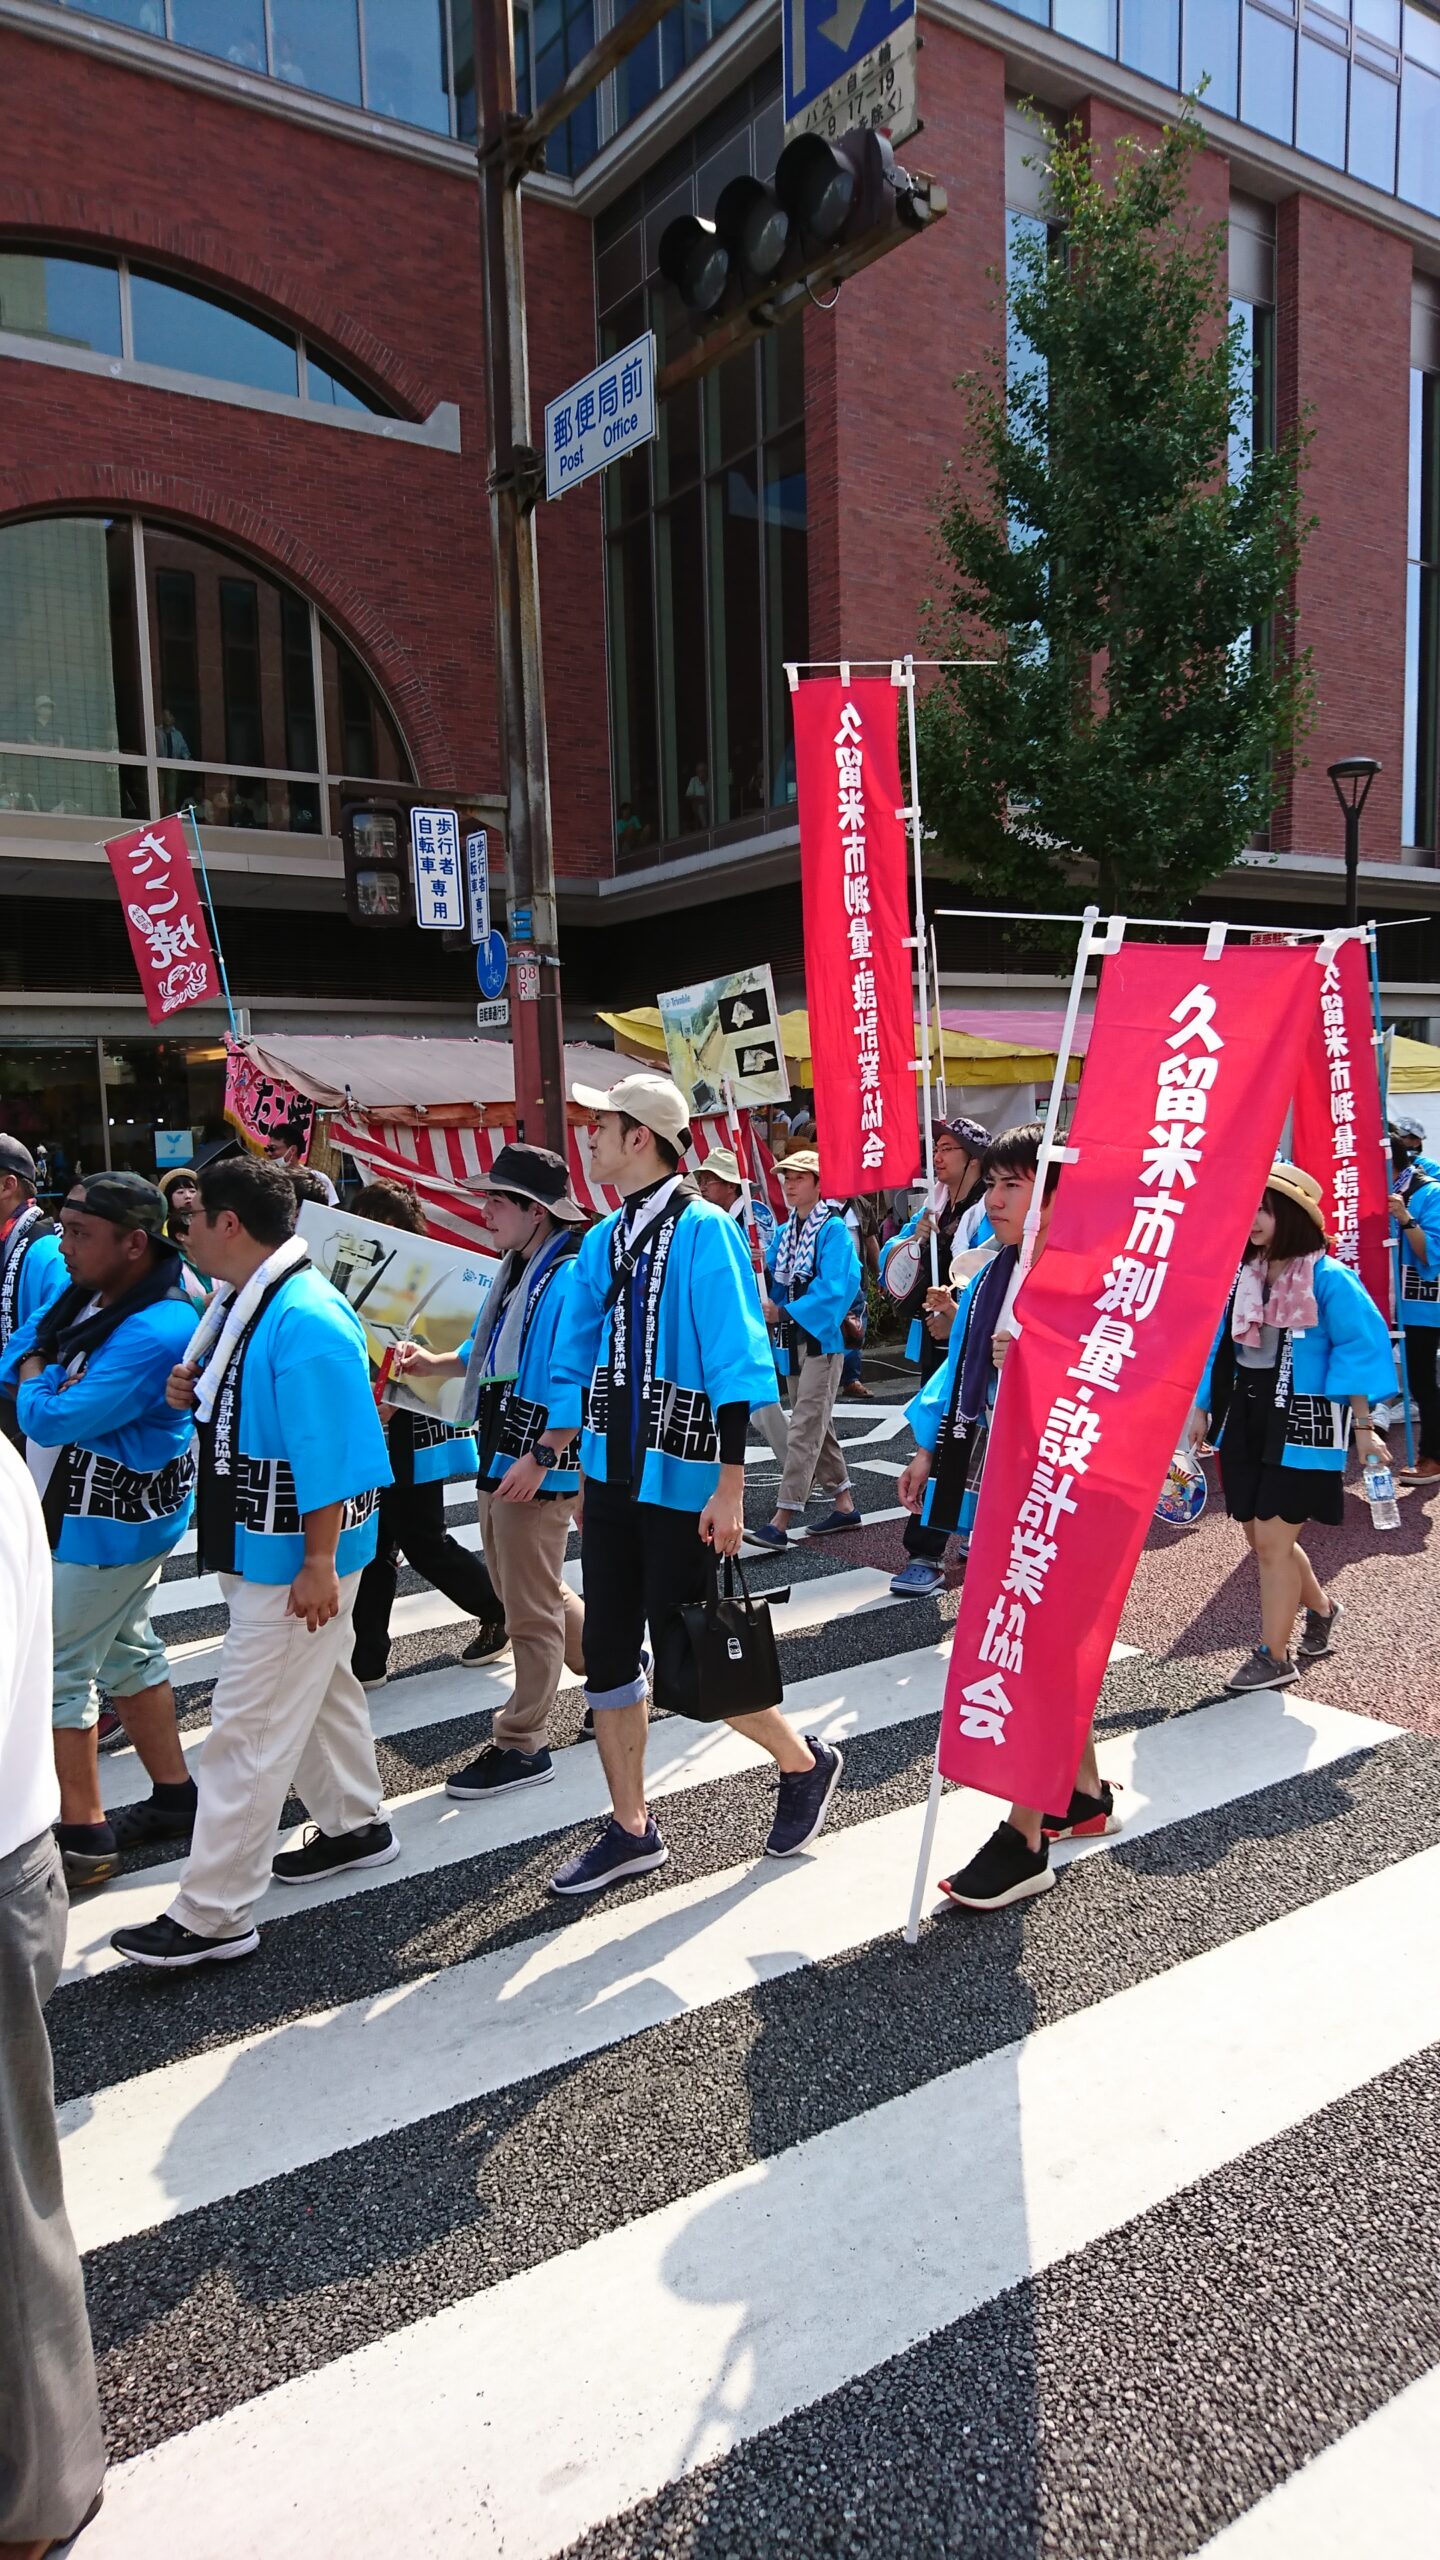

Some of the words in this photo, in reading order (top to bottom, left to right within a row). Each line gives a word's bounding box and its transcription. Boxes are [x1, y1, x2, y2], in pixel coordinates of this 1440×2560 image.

[554, 357, 643, 453] 郵便局前
[559, 444, 585, 477] Post
[603, 413, 639, 448] Office
[418, 816, 437, 875] 自転車
[436, 818, 454, 876] 歩行者
[430, 879, 448, 920] 専用
[520, 981, 528, 994] R
[958, 983, 1225, 1746] 久留米市測量・設計業協会
